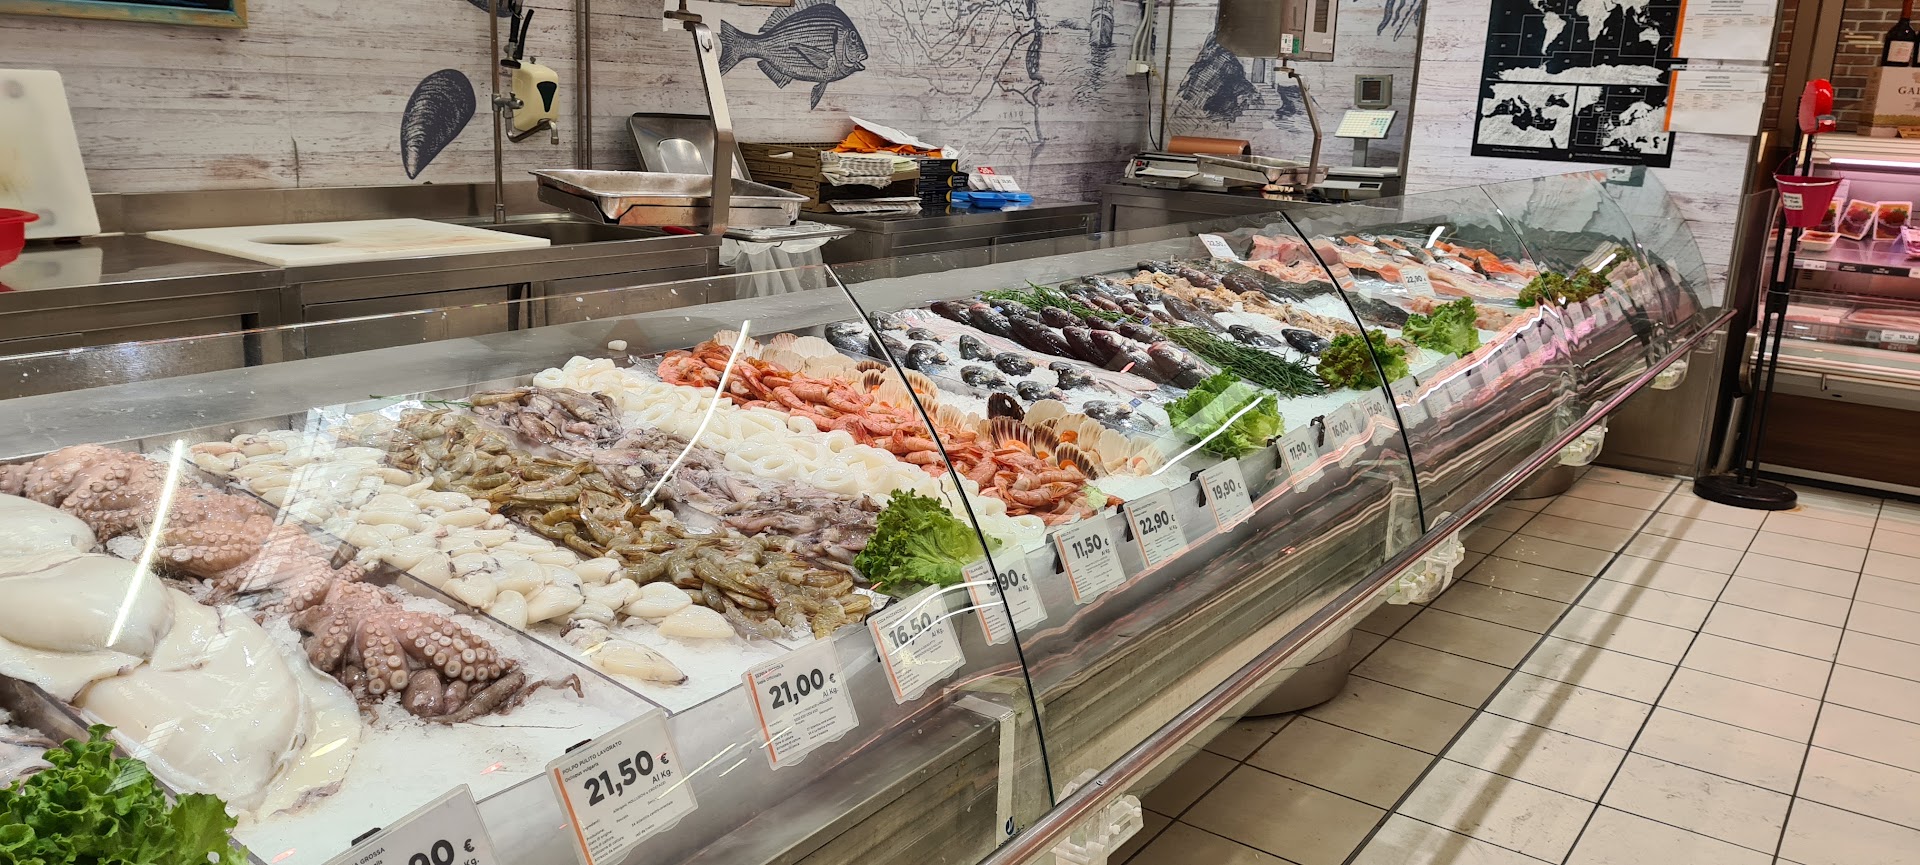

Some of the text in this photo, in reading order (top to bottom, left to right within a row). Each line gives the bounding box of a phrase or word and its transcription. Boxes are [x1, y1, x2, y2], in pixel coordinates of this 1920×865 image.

[1289, 441, 1307, 460] 11,90
[1212, 479, 1235, 500] 19,90
[1140, 510, 1169, 535] 22,90
[1072, 534, 1102, 559] 11,50
[987, 569, 1018, 596] 990
[889, 612, 931, 649] 16,50
[769, 668, 836, 709] 21,00 €
[562, 740, 622, 775] POLPO PULITO LAVORATO
[584, 750, 669, 806] 21,50 €
[652, 768, 673, 784] Al Kg.
[360, 847, 385, 865] GROSSA
[464, 839, 474, 852] €
